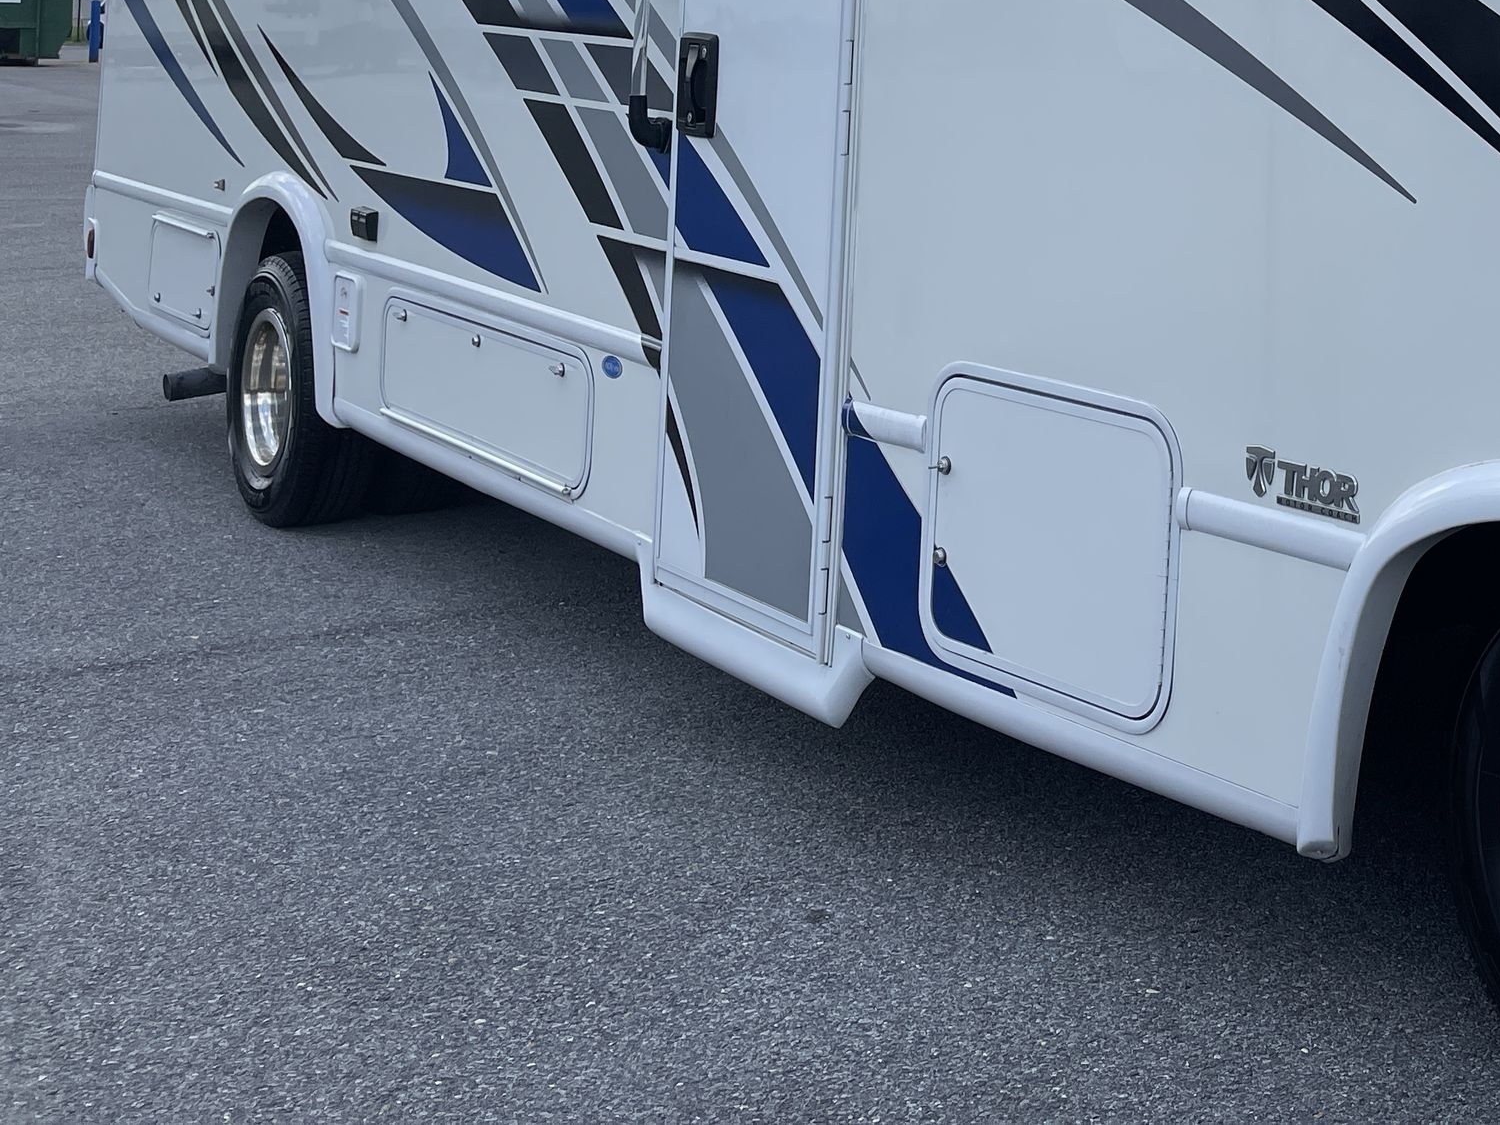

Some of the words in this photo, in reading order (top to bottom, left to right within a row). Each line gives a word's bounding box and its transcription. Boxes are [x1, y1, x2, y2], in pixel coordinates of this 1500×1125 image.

[1277, 459, 1359, 513] THOR
[1277, 496, 1313, 512] MOTOR
[1320, 504, 1360, 524] COACH
